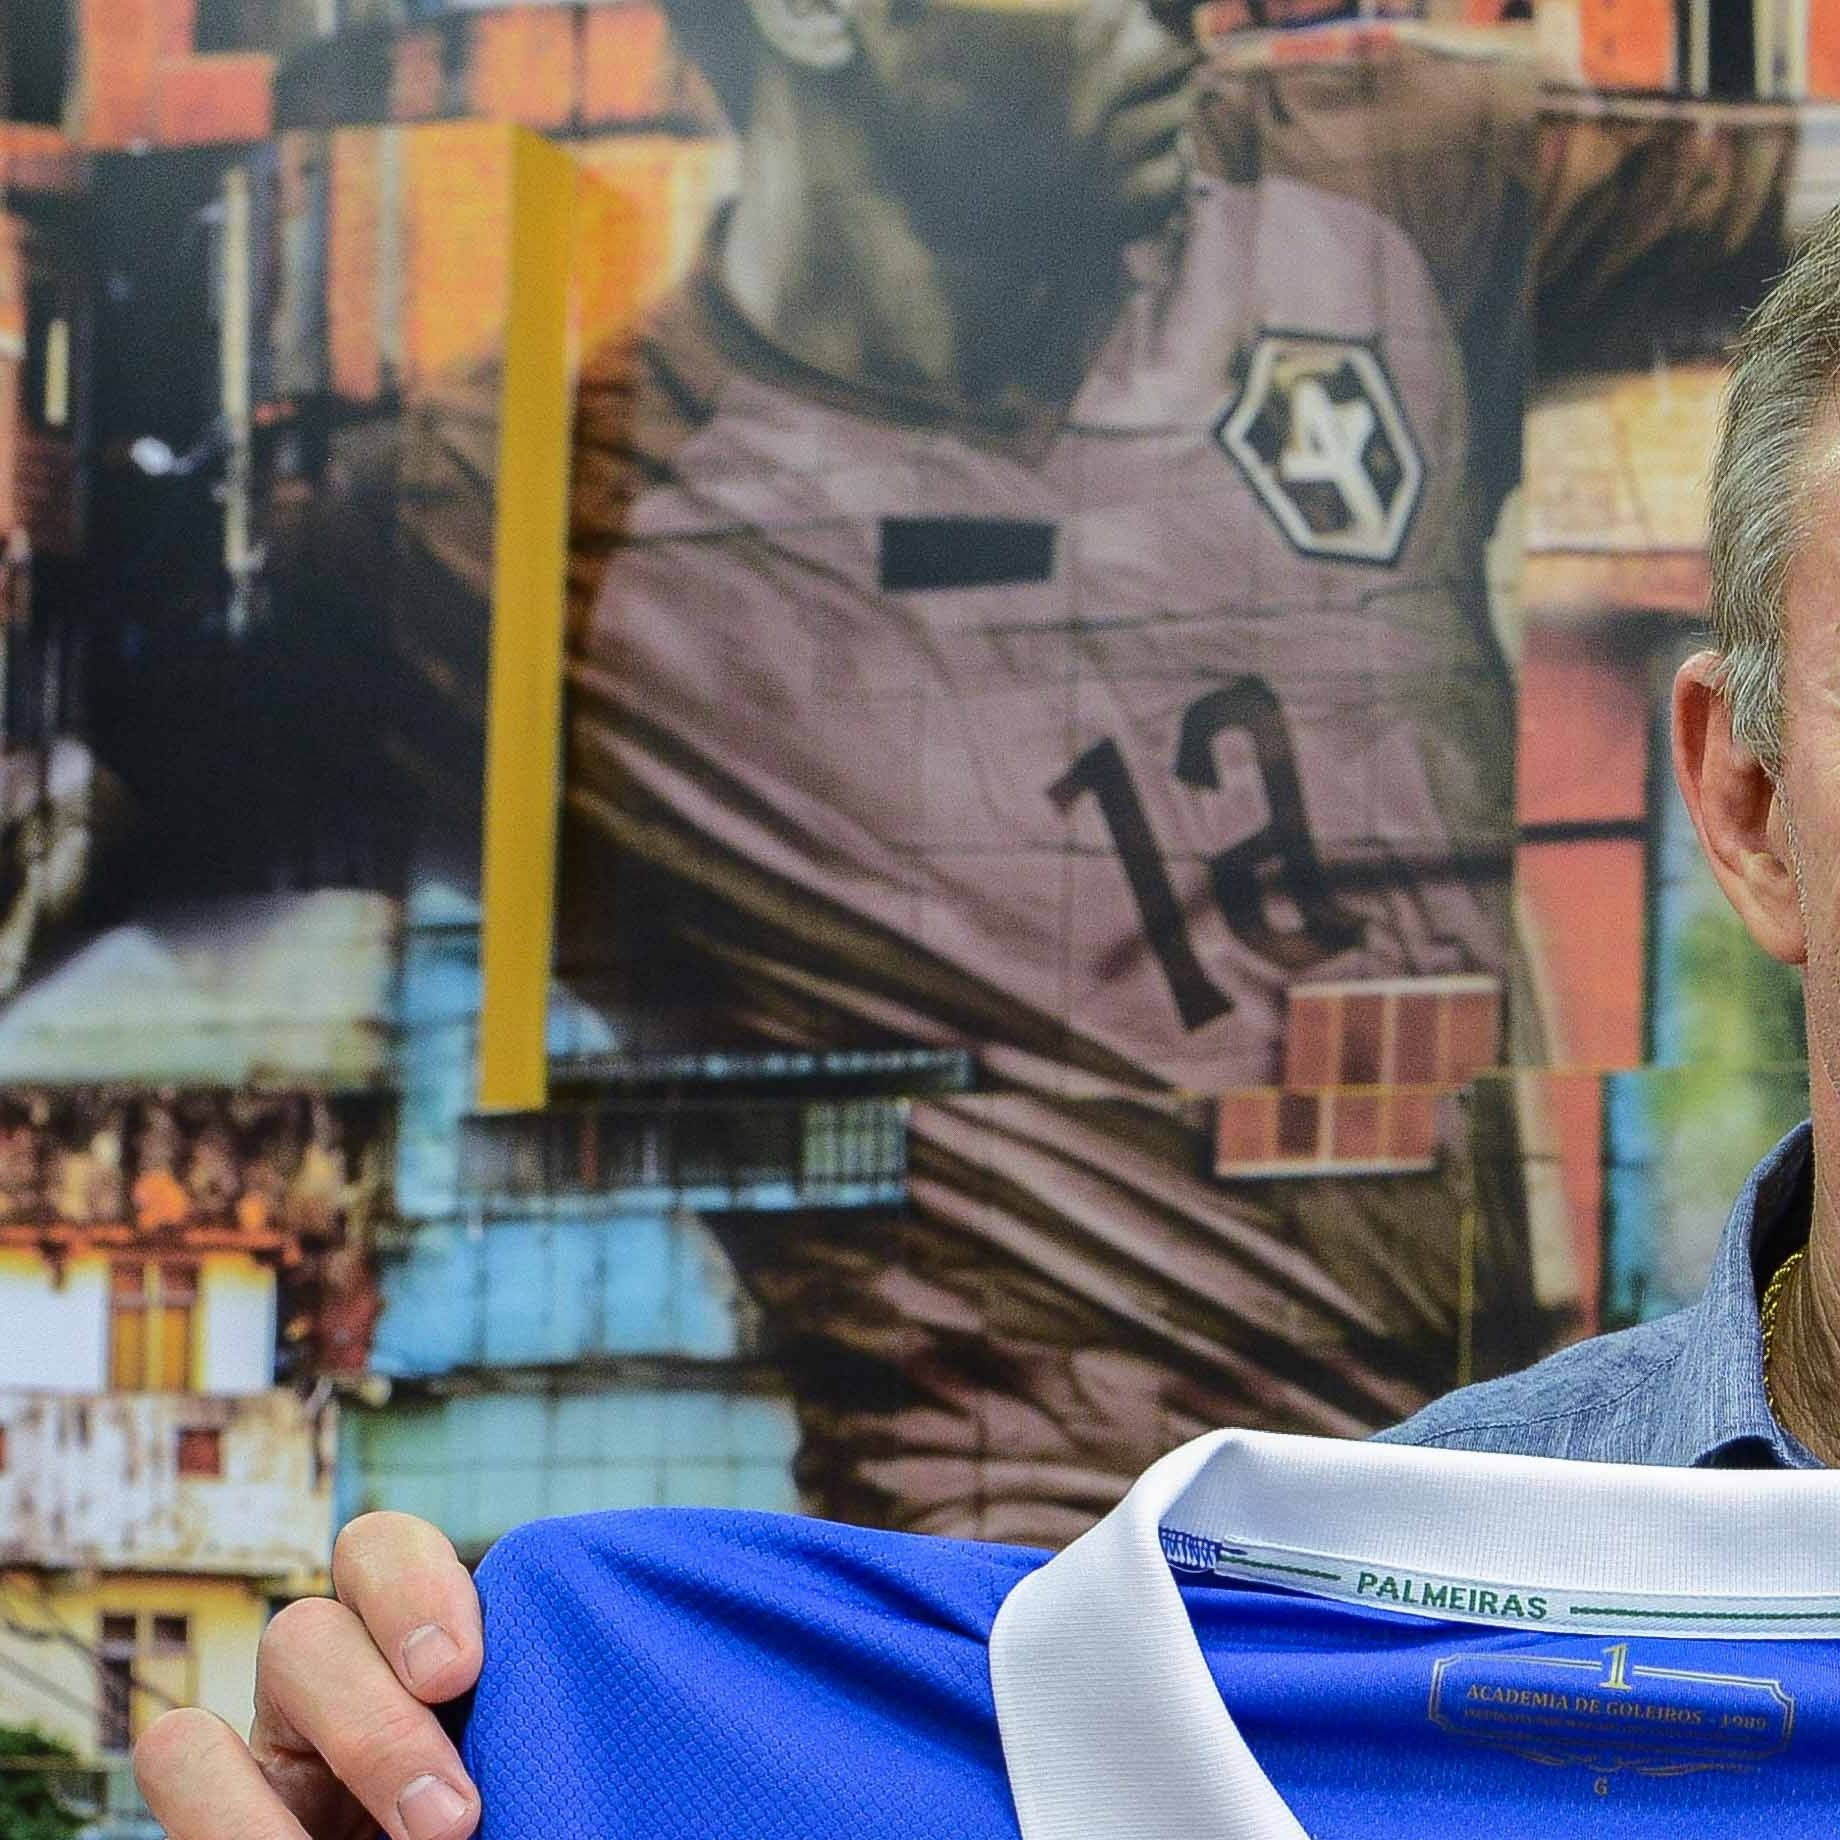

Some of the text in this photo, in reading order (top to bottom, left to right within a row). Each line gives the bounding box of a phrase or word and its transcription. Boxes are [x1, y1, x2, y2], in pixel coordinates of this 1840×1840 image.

[1356, 1570, 1548, 1620] PALMEIRAS
[1600, 1643, 1632, 1691] 1
[1466, 1683, 1569, 1711] ACADEMIA
[1575, 1697, 1601, 1714] DE
[1606, 1701, 1702, 1725] GOLEIROS
